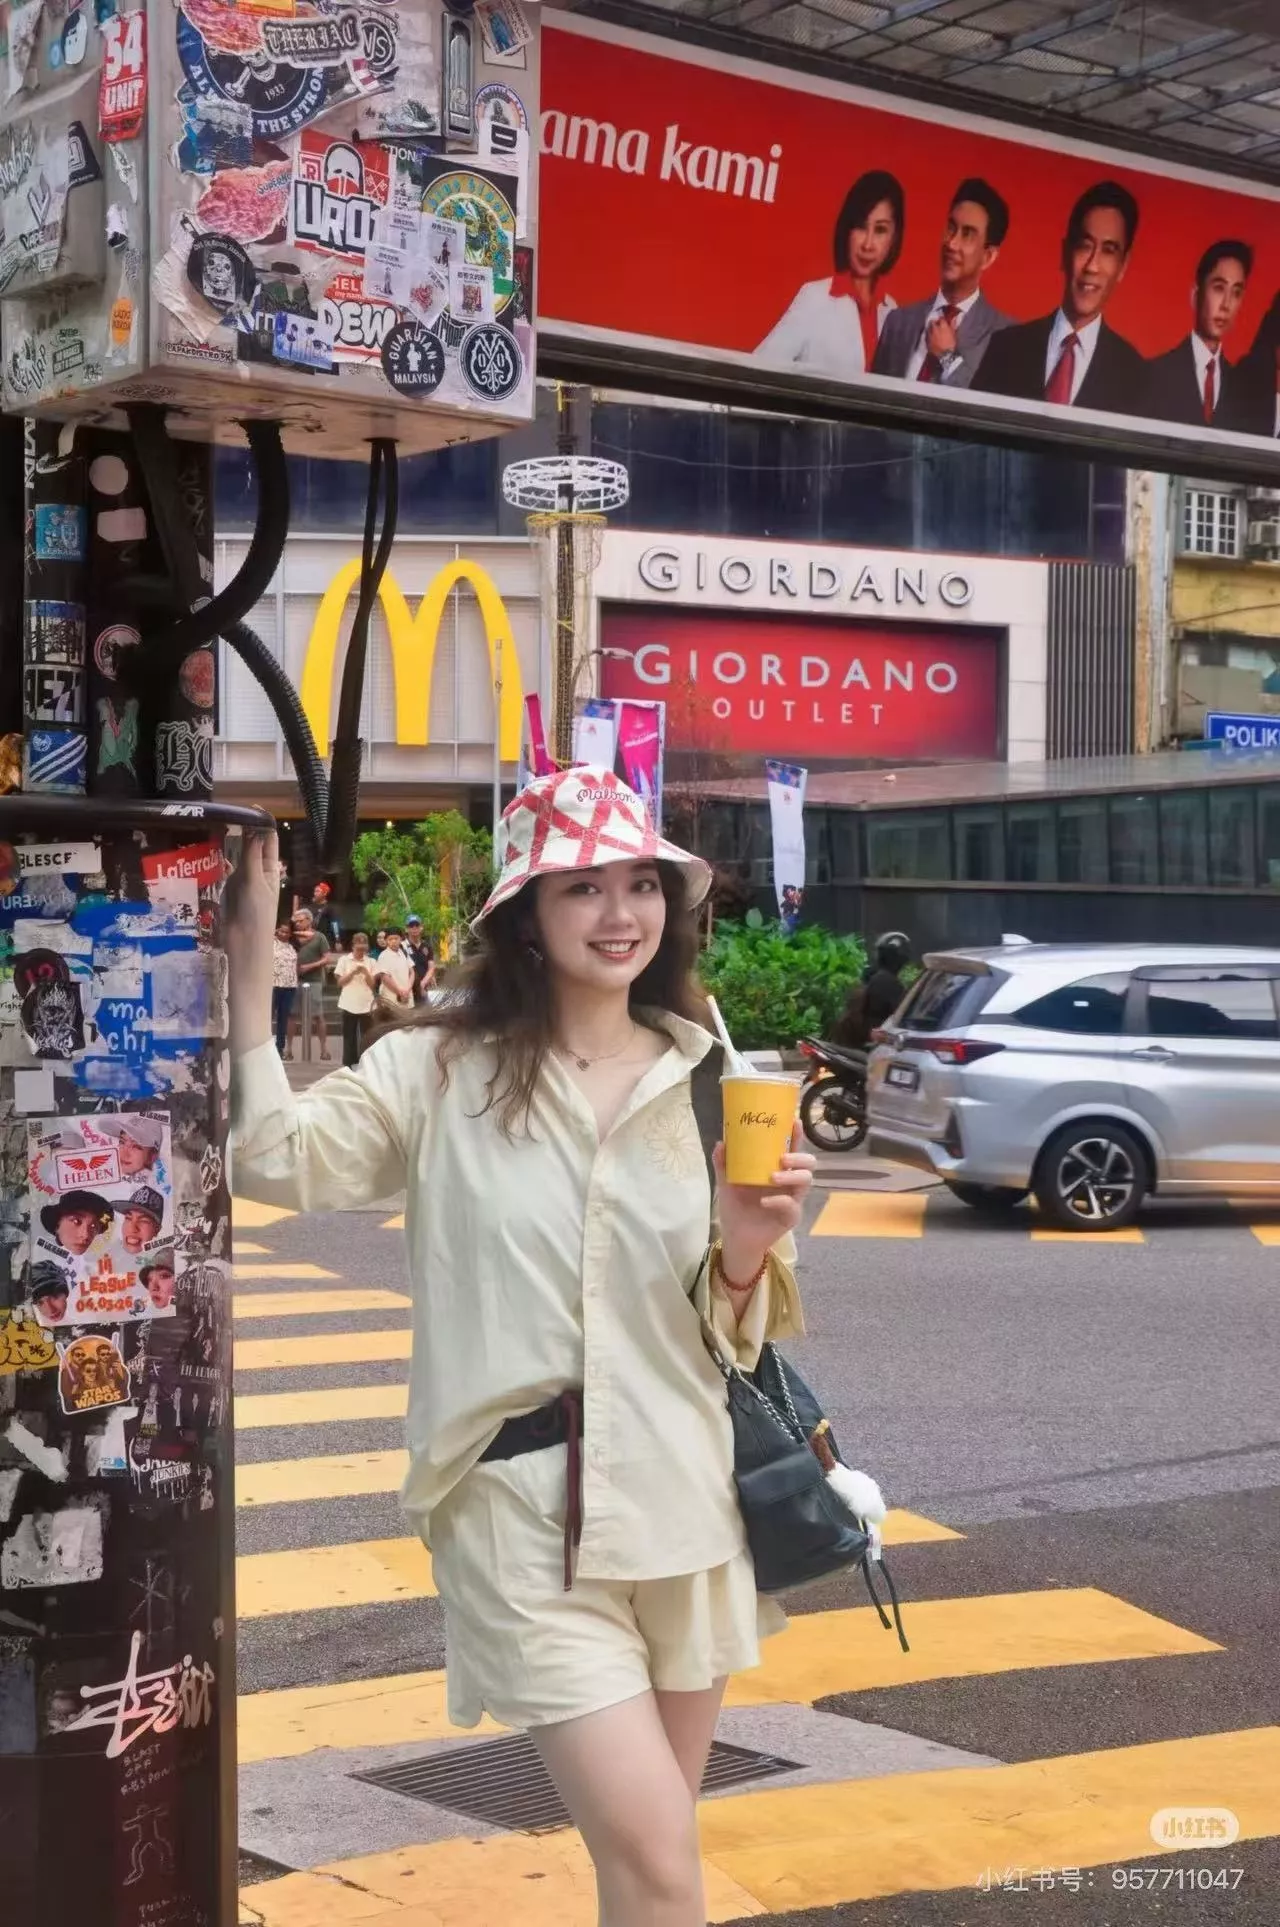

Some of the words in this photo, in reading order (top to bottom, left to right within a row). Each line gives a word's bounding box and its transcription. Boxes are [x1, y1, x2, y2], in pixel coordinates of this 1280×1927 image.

[105, 79, 143, 113] UNIT
[256, 115, 291, 133] THE
[660, 123, 782, 202] kami
[394, 373, 437, 384] MALAYSIA
[638, 545, 975, 606] GIORDANO
[632, 643, 958, 694] GIORDANO
[712, 698, 884, 726] OUTLET
[64, 1167, 114, 1185] HELEN
